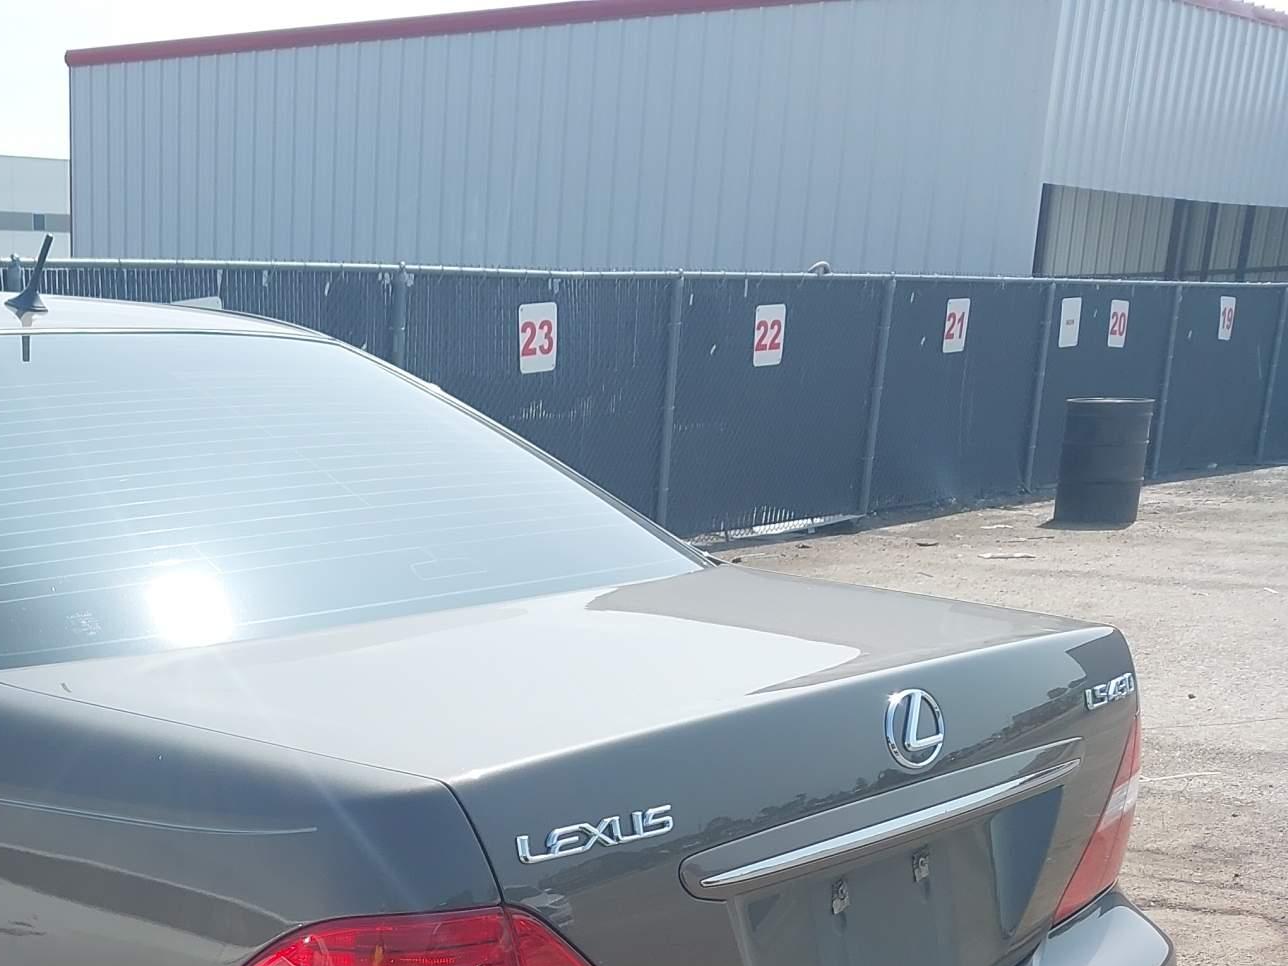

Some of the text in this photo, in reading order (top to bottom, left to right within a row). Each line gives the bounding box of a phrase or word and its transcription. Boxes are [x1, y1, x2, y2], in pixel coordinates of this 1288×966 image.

[944, 312, 966, 340] 21
[1109, 311, 1127, 337] 20
[1221, 307, 1233, 330] 19
[520, 319, 554, 357] 23
[755, 319, 782, 351] 22
[516, 803, 674, 864] LEXUS
